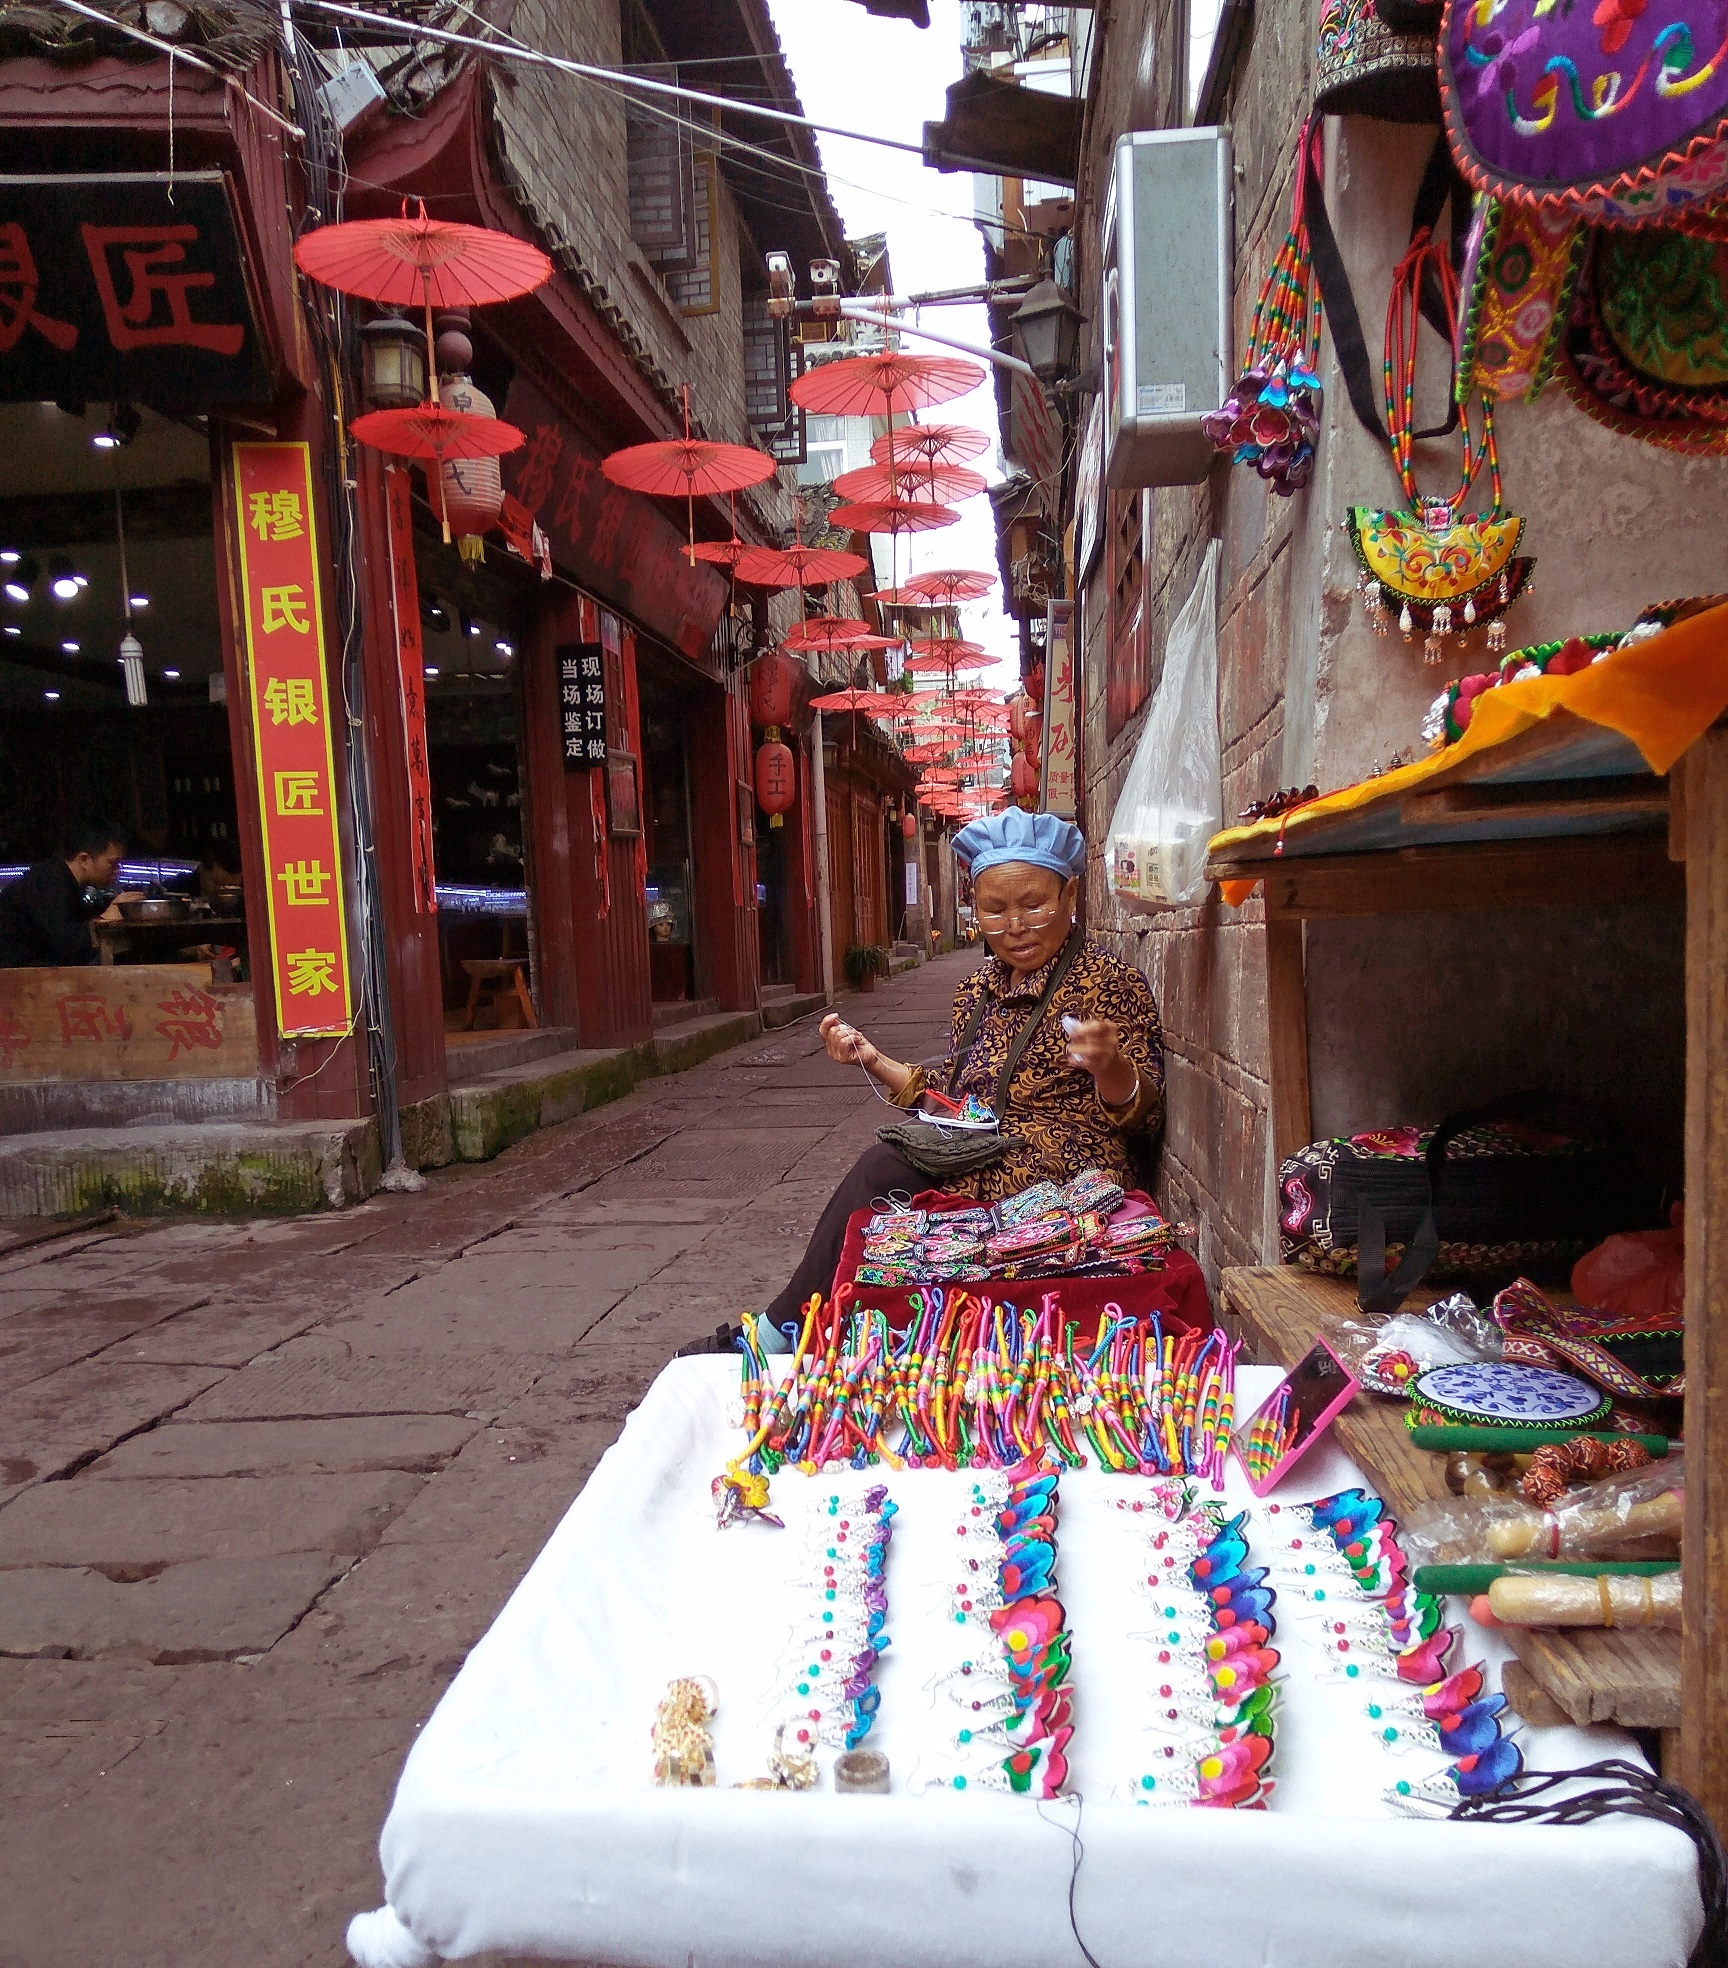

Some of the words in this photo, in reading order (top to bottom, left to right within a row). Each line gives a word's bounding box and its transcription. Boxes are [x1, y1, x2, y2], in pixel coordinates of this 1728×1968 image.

[249, 489, 339, 997] 穆氏银匠世家
[562, 659, 584, 758] 当场鉴定
[581, 656, 606, 759] 现场订做
[768, 753, 787, 795] 手工
